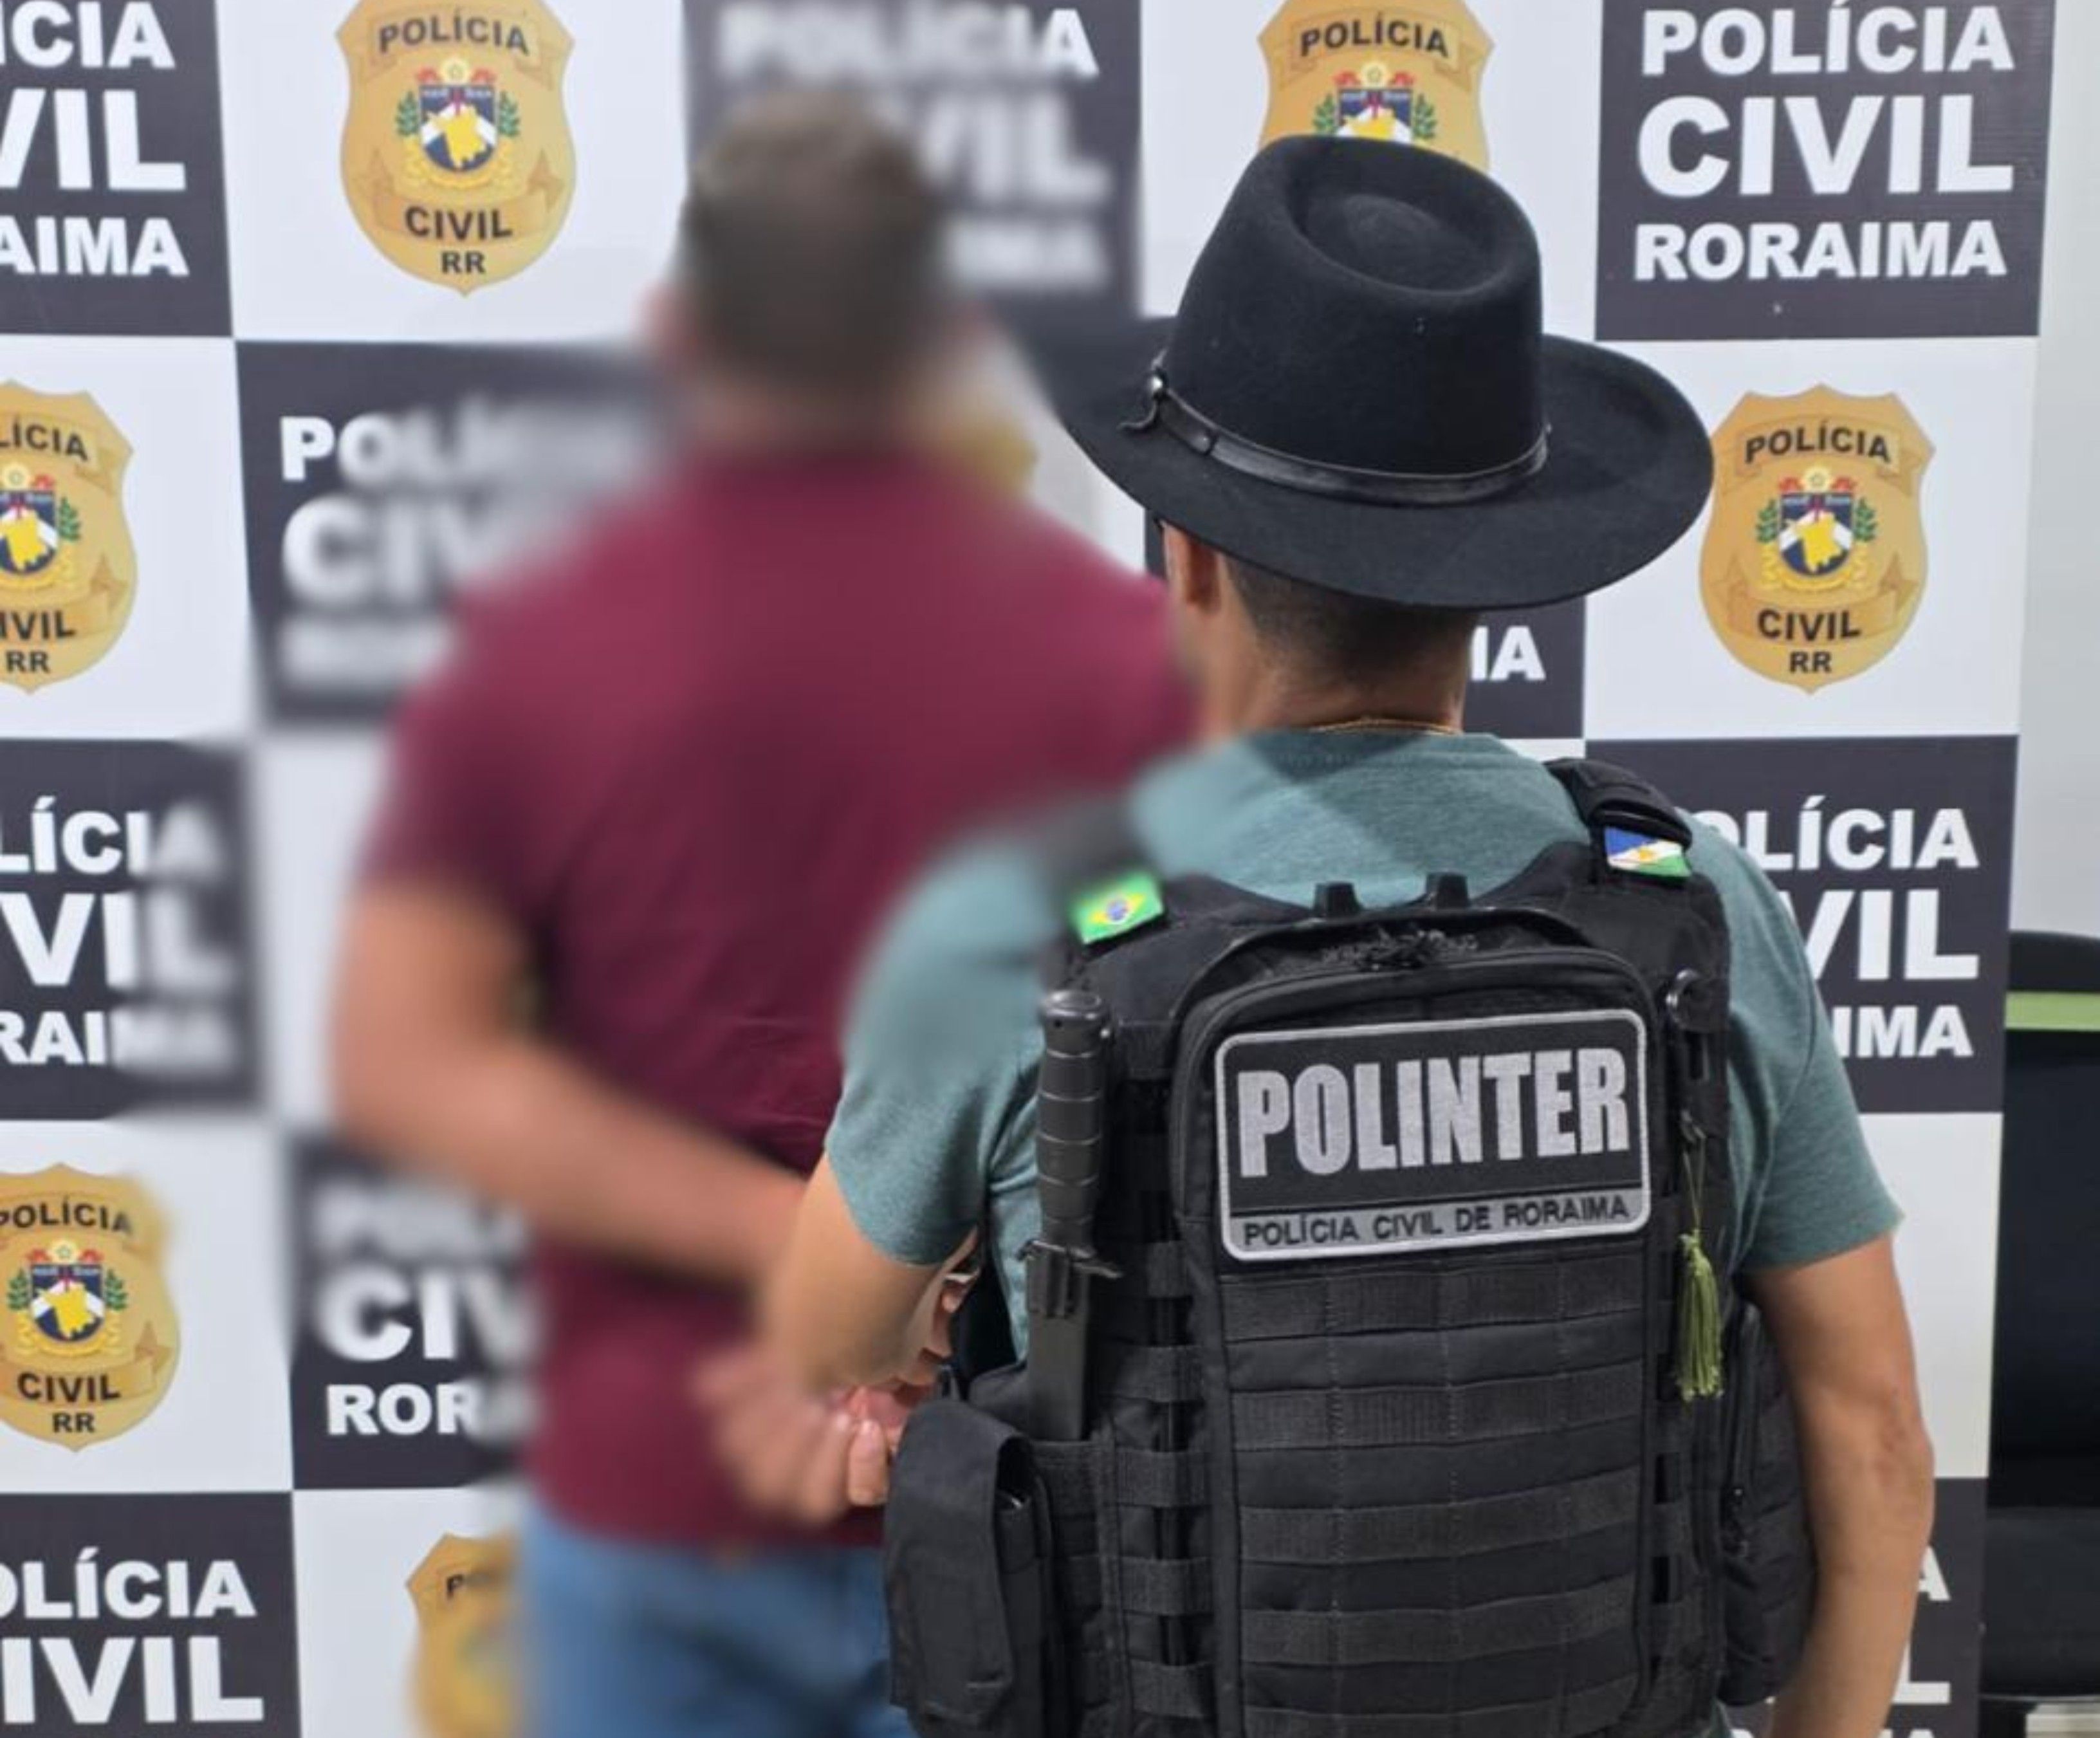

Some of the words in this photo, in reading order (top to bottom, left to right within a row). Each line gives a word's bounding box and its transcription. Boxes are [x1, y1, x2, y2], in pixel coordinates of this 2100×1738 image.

[0, 0, 176, 68] CIA
[378, 8, 530, 56] POLÍCIA
[1300, 12, 1449, 59] POLÍCIA
[1642, 0, 2015, 76] POLÍCIA
[1637, 94, 2014, 198] CIVIL
[404, 205, 513, 241] CIVIL
[441, 250, 486, 274] RR
[1634, 220, 2007, 281] RORAIMA
[1744, 420, 1891, 464] POLÍCIA
[1757, 608, 1861, 642] CIVIL
[6, 651, 50, 673] RR
[1790, 651, 1832, 674] RR
[1237, 1047, 1630, 1179] POLINTER
[1244, 1214, 1360, 1246] POLÍCIA
[1372, 1211, 1442, 1239] CIVIL
[1455, 1207, 1489, 1233] DE
[1503, 1195, 1630, 1228] RORAIMA
[17, 1372, 121, 1403] CIVIL
[51, 1412, 95, 1434] RR
[1, 1636, 265, 1724] IVIL
